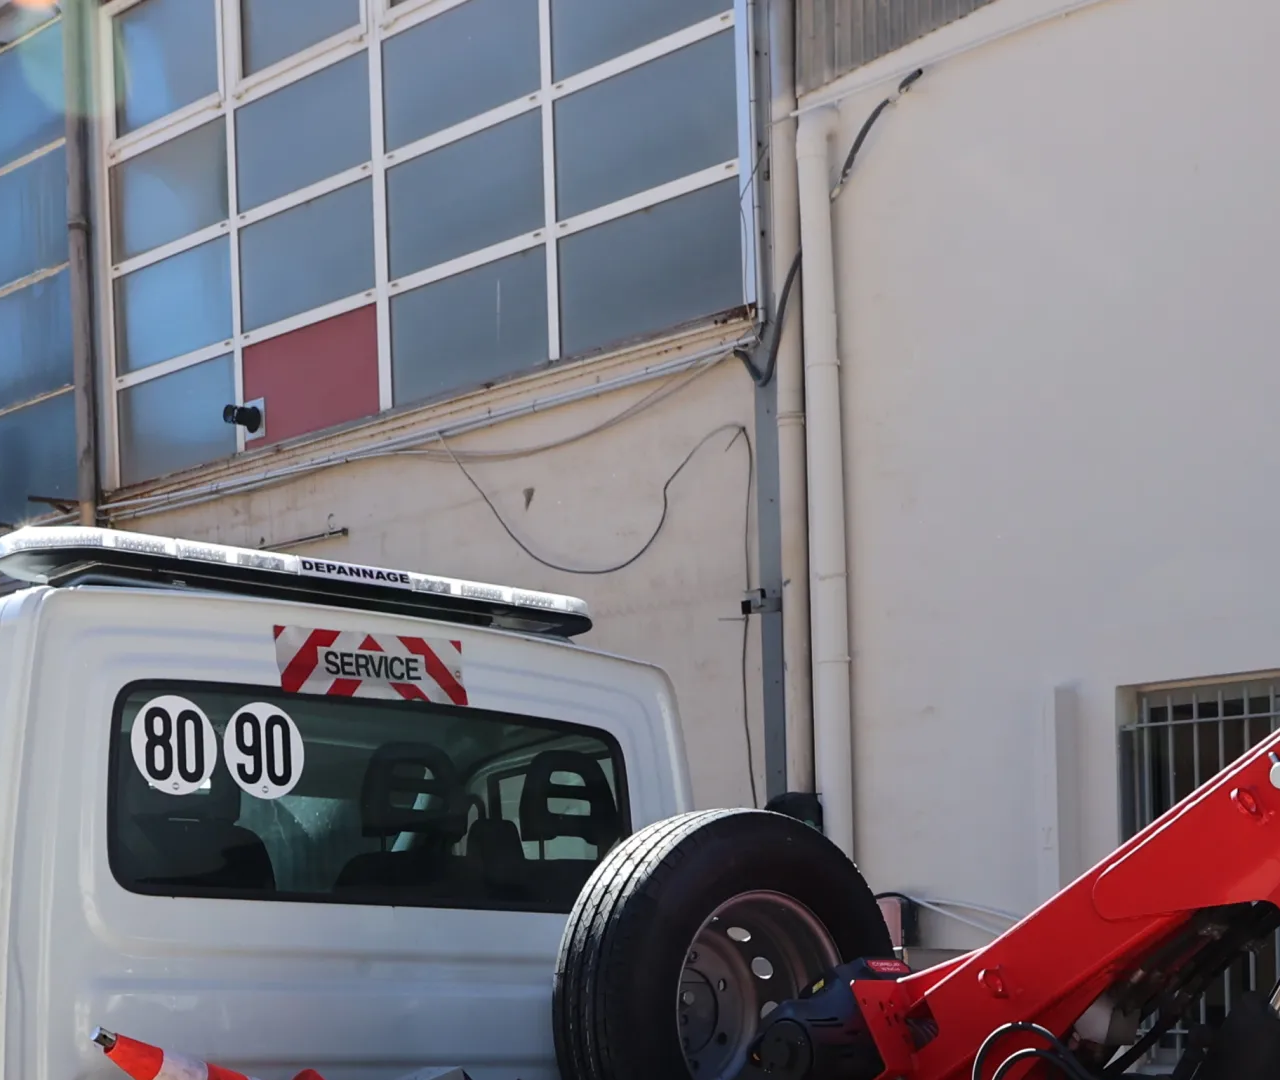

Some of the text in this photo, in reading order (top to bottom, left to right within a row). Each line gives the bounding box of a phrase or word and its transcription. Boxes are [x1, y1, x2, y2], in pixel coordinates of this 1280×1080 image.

[302, 560, 411, 585] DEPANNAGE
[324, 651, 422, 681] SERVICE
[144, 706, 205, 783] 80
[235, 711, 292, 786] 90
